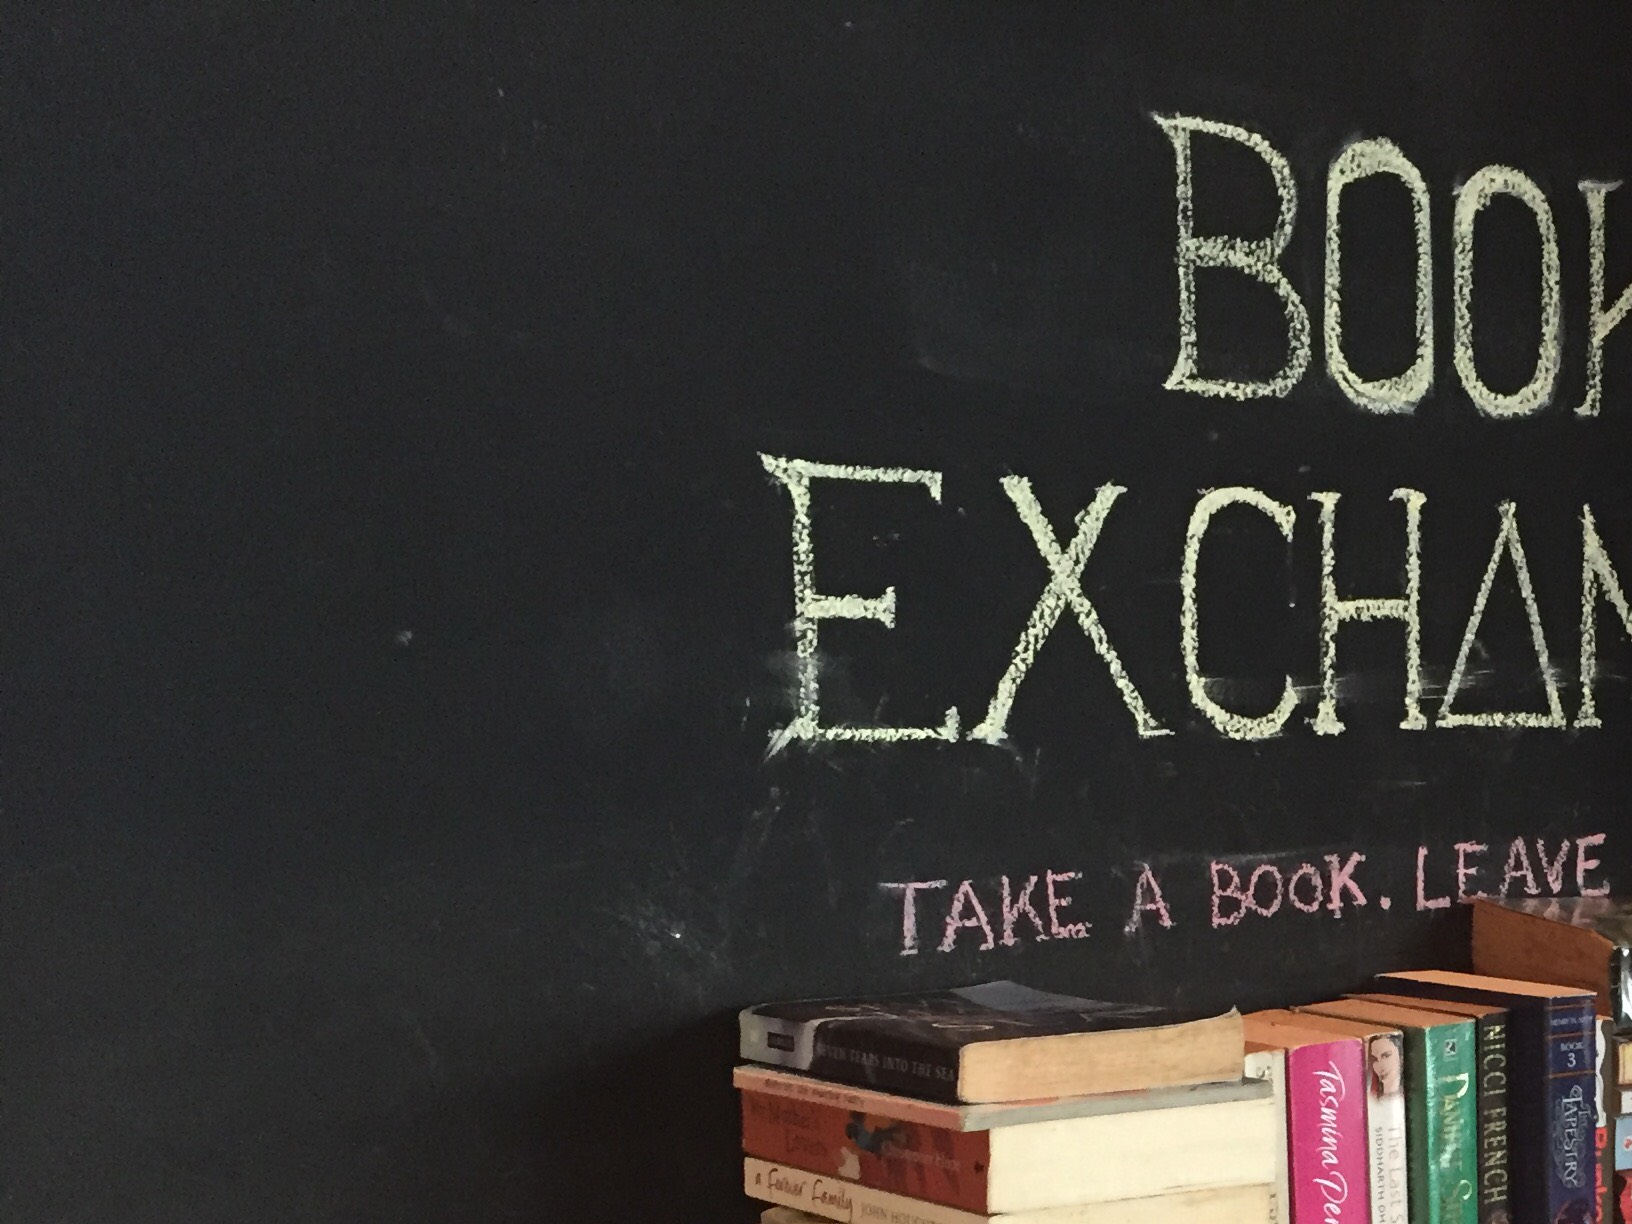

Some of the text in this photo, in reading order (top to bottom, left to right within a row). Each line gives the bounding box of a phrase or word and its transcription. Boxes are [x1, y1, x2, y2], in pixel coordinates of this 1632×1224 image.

[878, 869, 1093, 956] TAKE
[1124, 861, 1176, 936] A
[1211, 851, 1391, 930] BOOK.
[1416, 833, 1610, 911] LEAVE
[1566, 1053, 1577, 1068] 3
[1313, 1060, 1346, 1171] Tasmina
[1483, 1025, 1509, 1206] NICCI FRENCH
[859, 1203, 888, 1220] JOHN
[1388, 1167, 1403, 1210] Last
